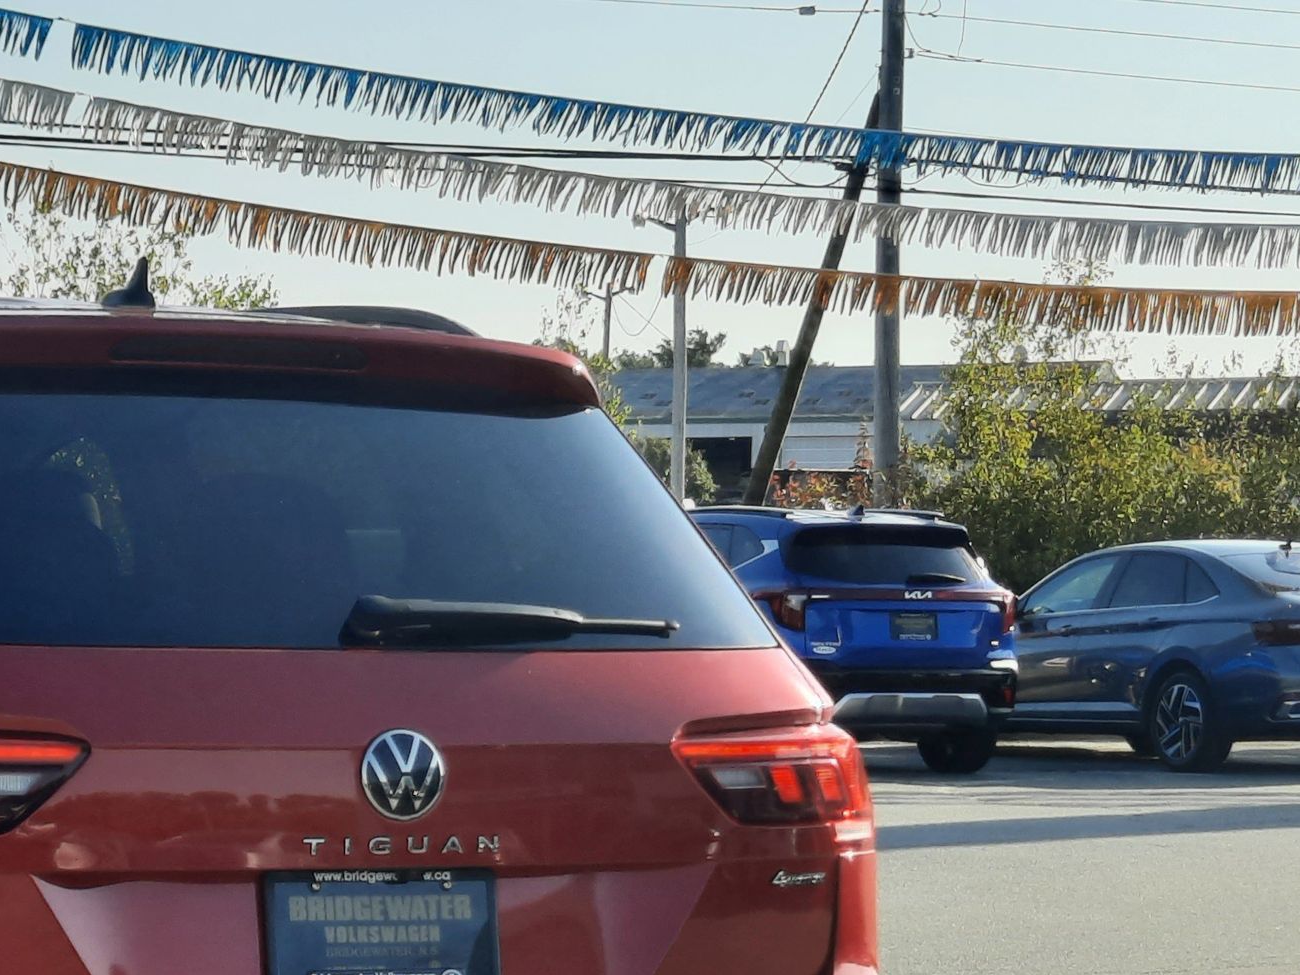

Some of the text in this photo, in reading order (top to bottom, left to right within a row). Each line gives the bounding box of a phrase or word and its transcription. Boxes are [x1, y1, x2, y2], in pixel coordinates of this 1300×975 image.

[303, 836, 499, 856] TIGUAN
[288, 894, 472, 921] BRIDGEWATER
[324, 925, 441, 943] VOLKSWAGEN
